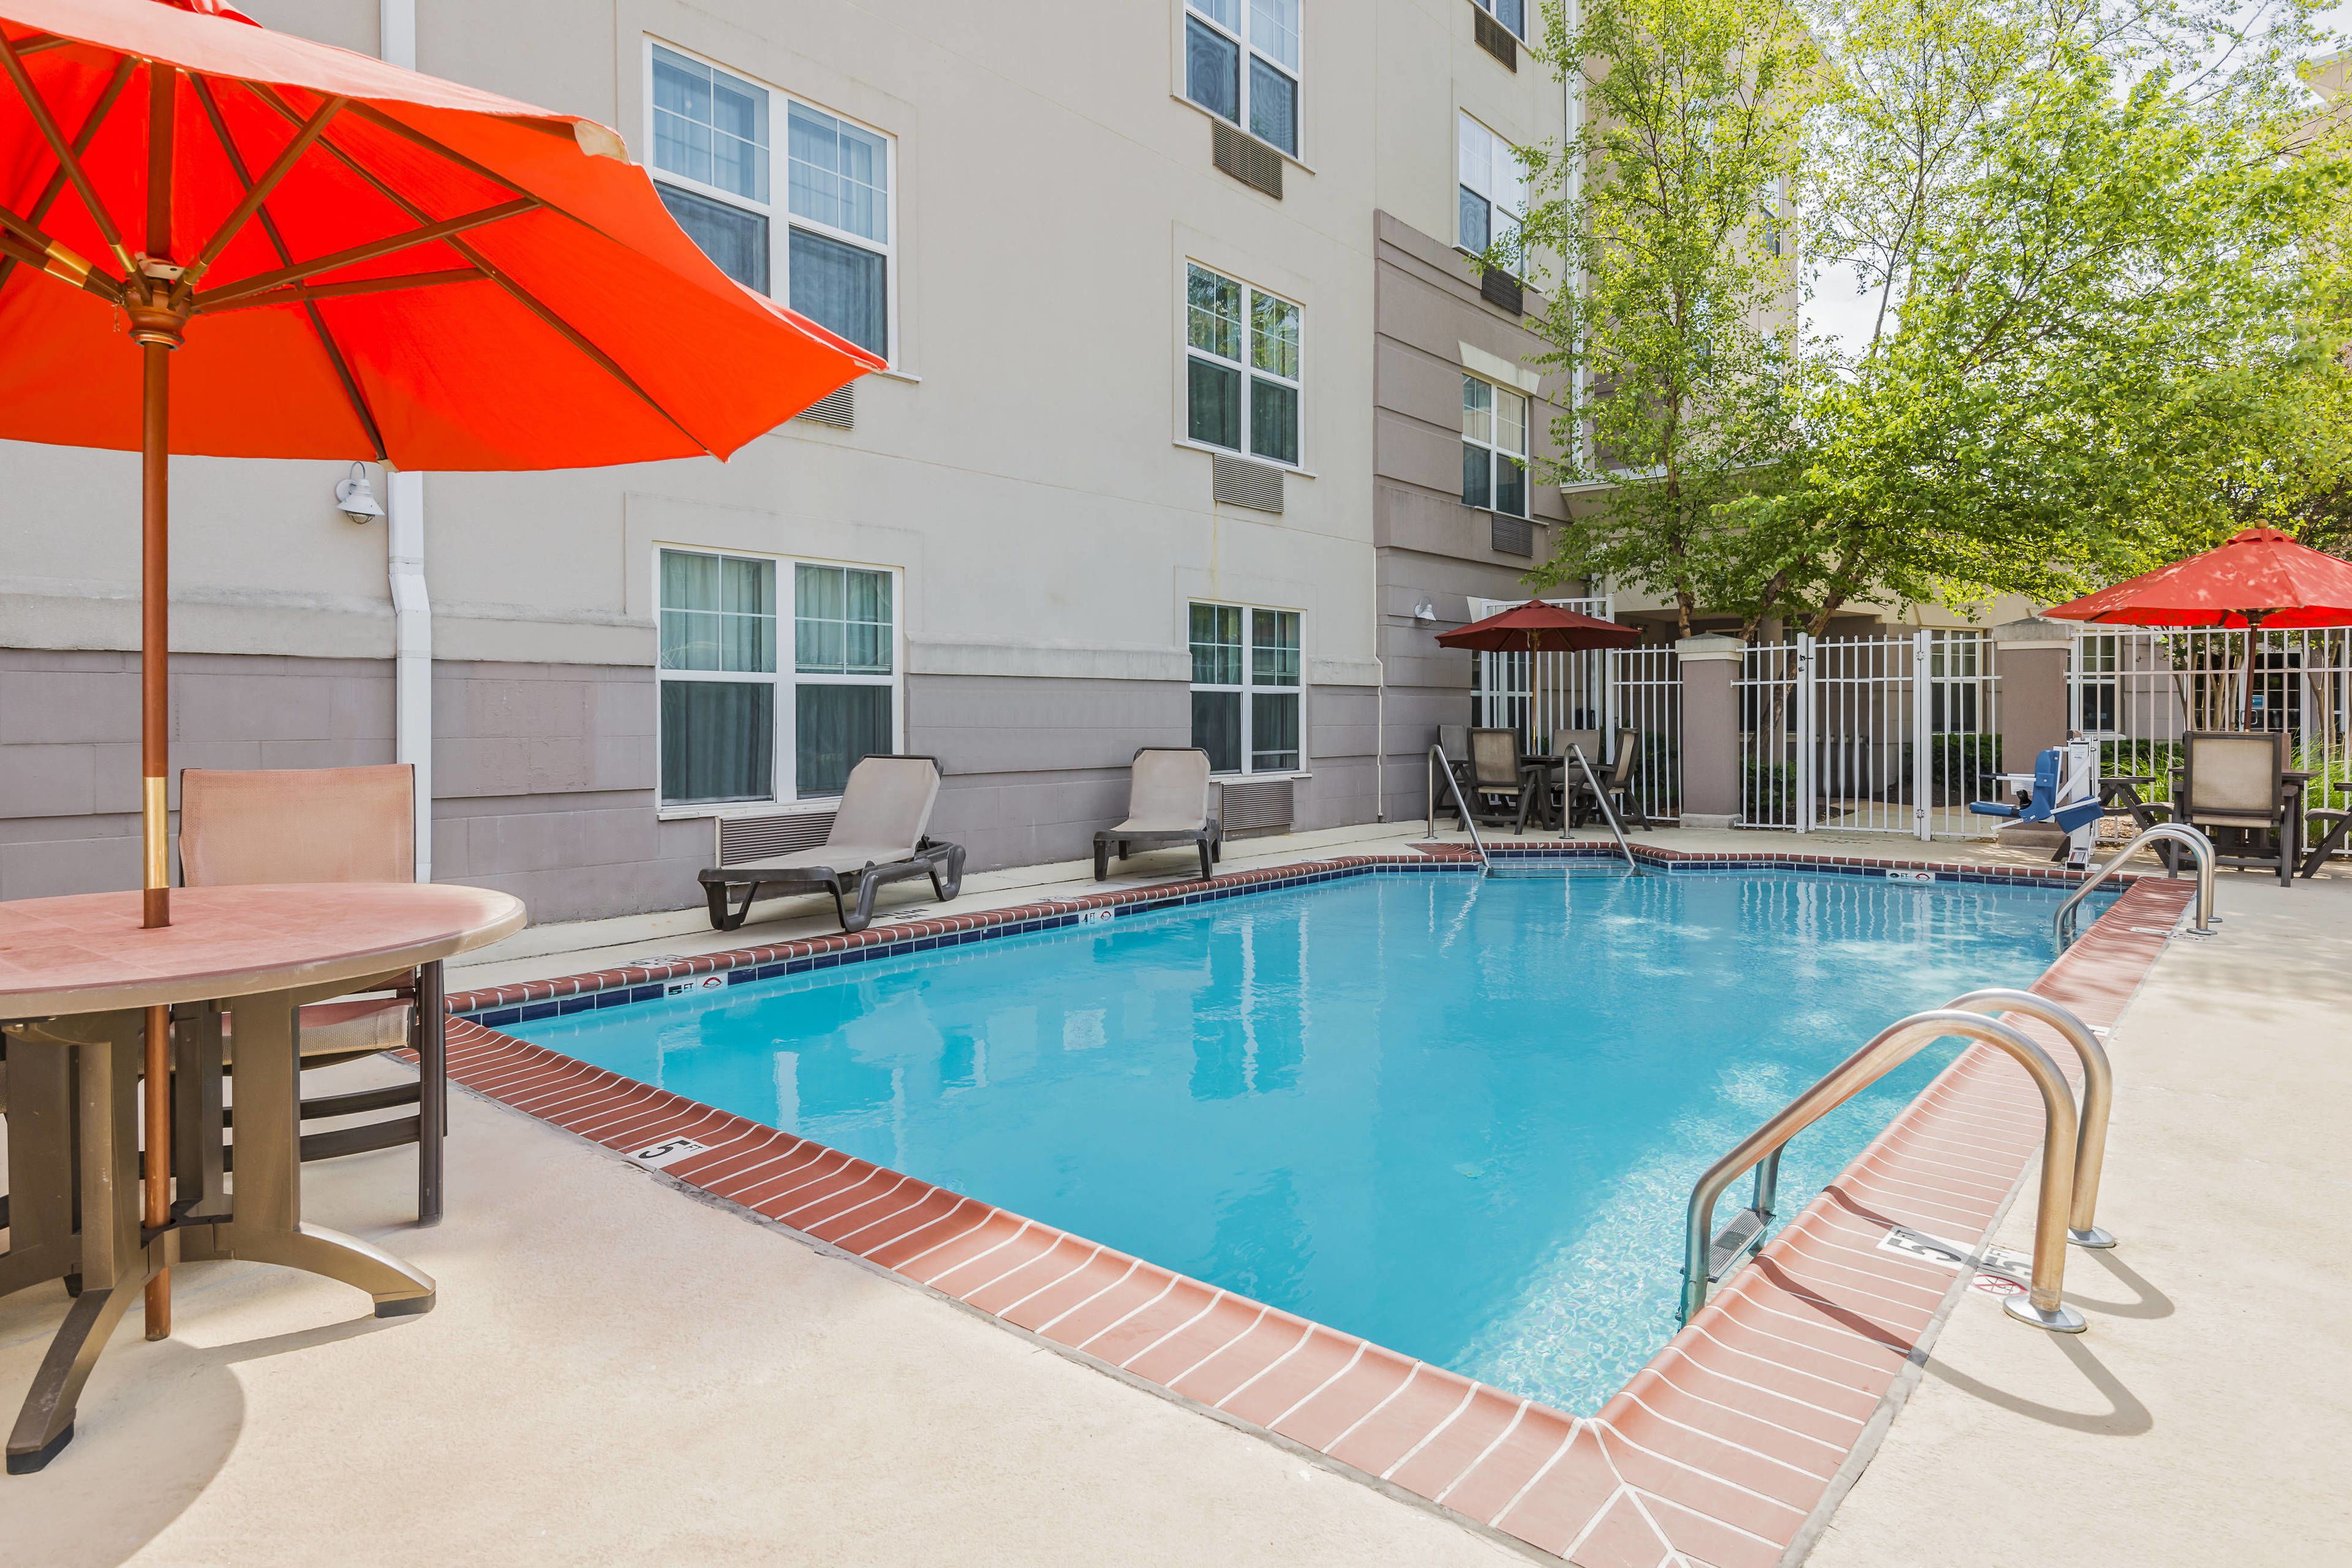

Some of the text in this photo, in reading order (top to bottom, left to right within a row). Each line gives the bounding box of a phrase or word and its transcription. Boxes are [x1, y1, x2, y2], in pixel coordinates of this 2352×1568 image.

[668, 984, 683, 995] 5
[638, 1139, 691, 1159] 5
[1886, 1229, 1962, 1262] 5 FT
[1981, 1248, 2033, 1276] 5 FT
